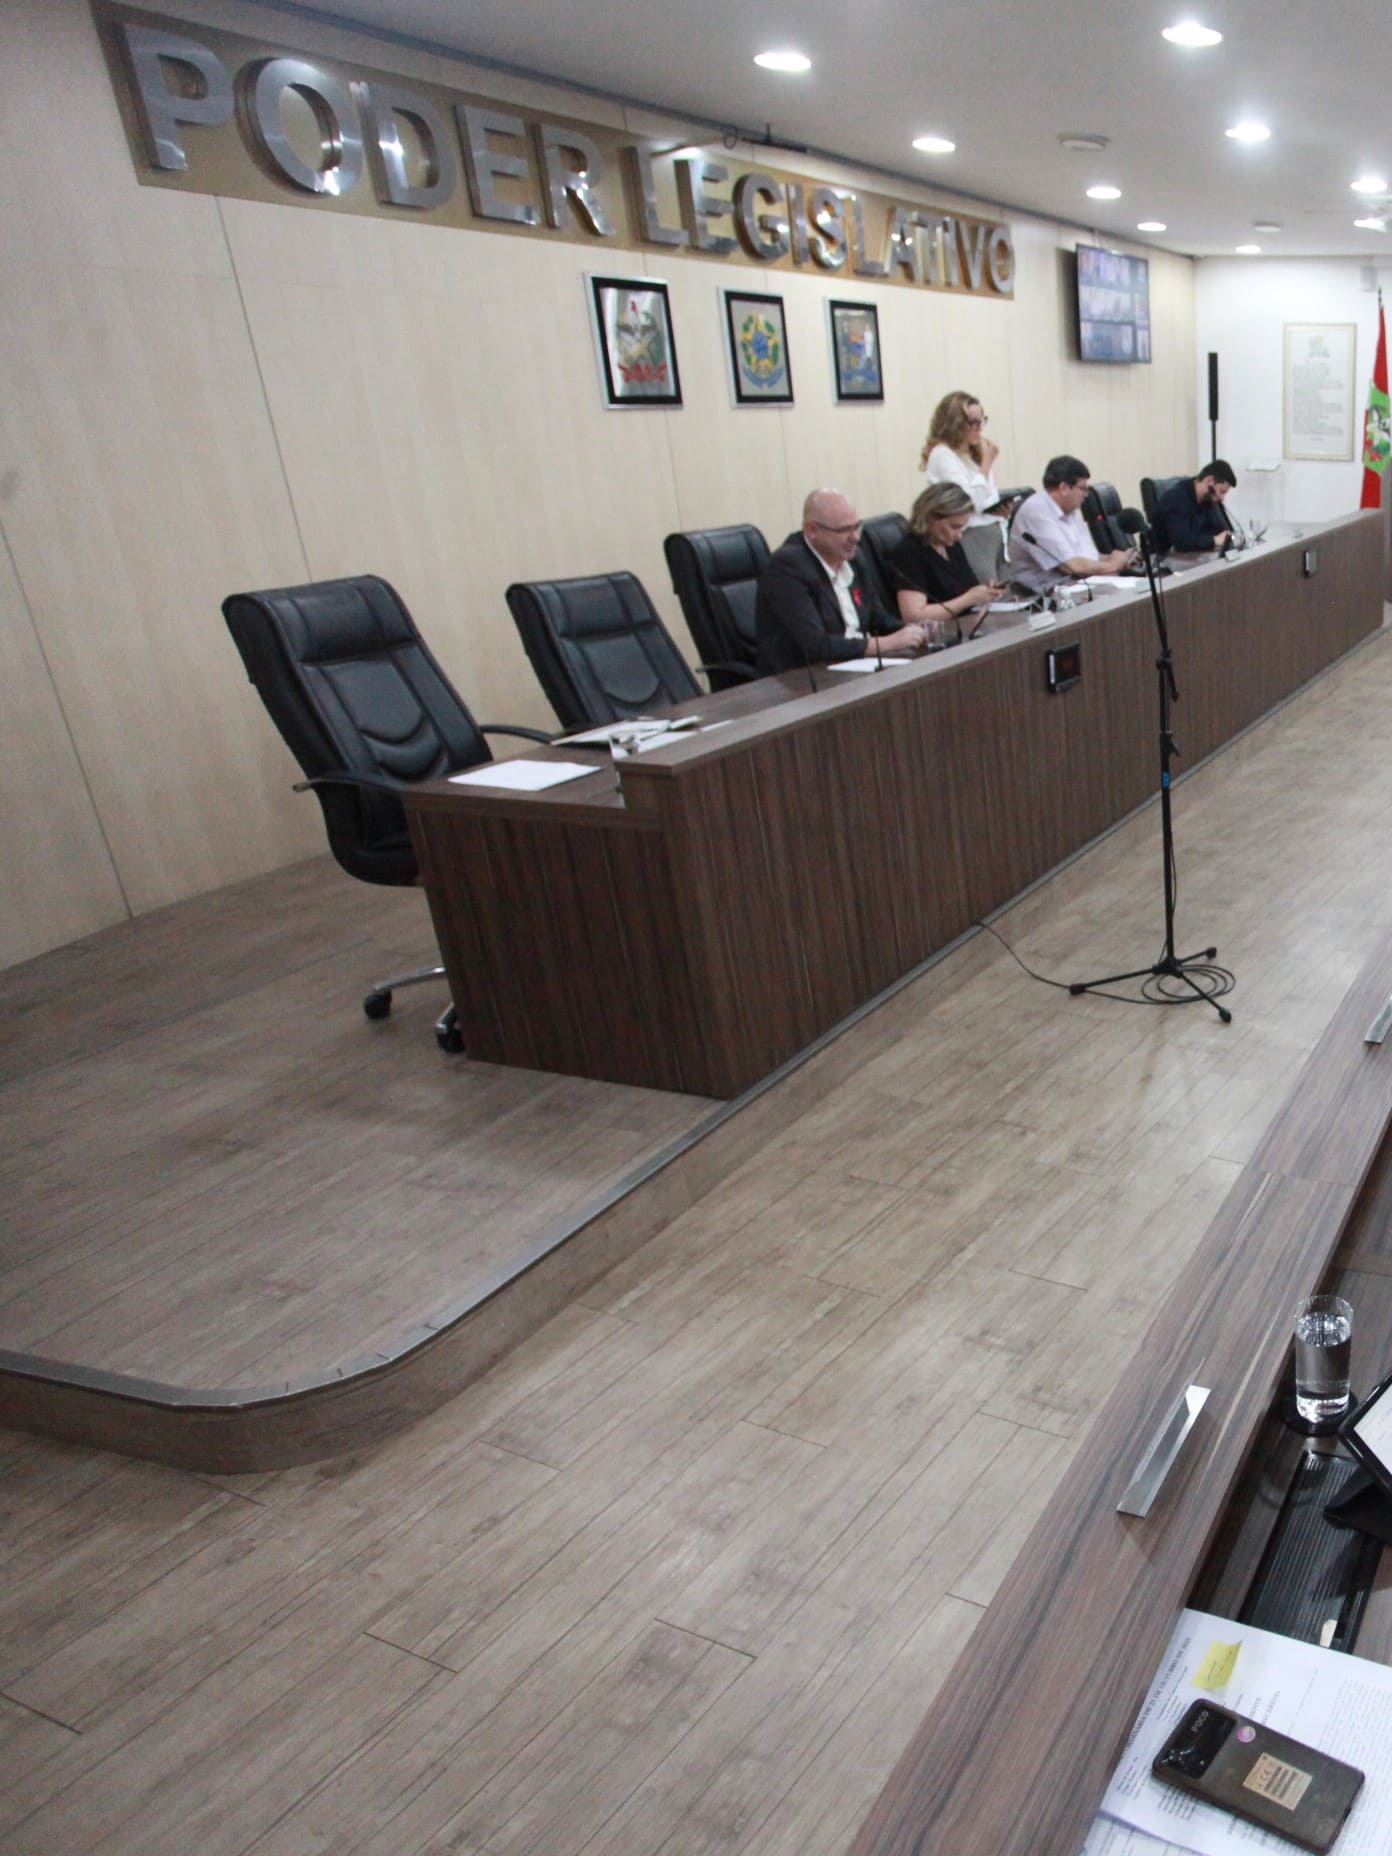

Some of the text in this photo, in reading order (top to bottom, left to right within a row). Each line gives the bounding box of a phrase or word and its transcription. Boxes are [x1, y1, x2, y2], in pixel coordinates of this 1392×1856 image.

[119, 21, 1016, 296] PODER LEGISLATIVO
[1191, 1711, 1209, 1732] POCO
